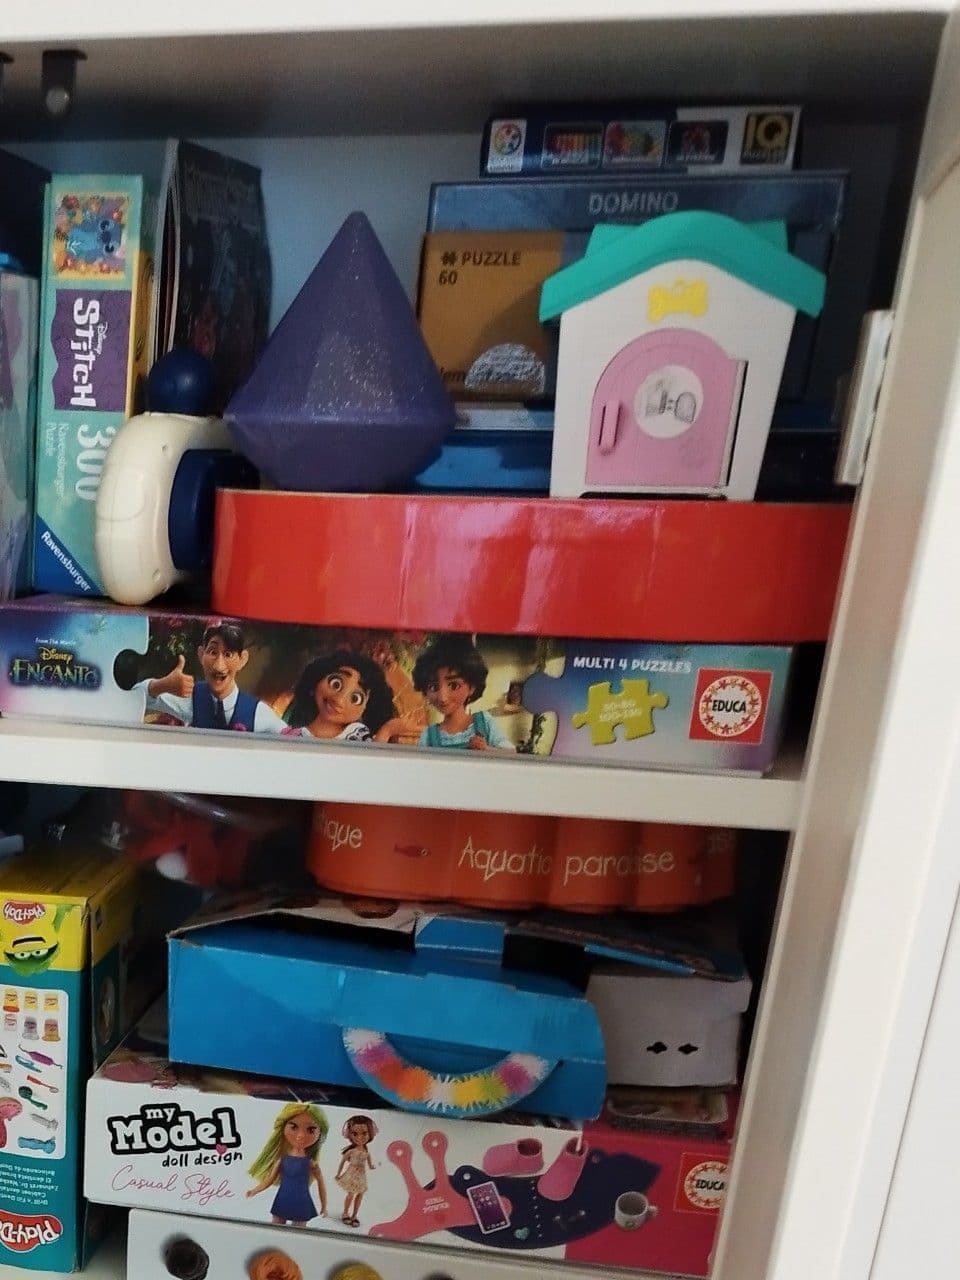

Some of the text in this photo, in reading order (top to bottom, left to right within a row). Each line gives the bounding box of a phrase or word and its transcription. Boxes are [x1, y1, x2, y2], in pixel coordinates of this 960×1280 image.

[588, 192, 679, 217] DOMINO
[461, 250, 522, 267] PUZZLE
[438, 270, 458, 286] 60
[41, 530, 92, 592] Ravensburger
[39, 647, 73, 664] Disney
[9, 659, 100, 686] ENCANTO
[573, 656, 693, 674] MULTI 4 PUZZLES
[711, 699, 747, 713] EDUCA
[458, 836, 551, 881] Aquatic
[145, 1107, 176, 1122] my
[111, 1112, 236, 1150] Model
[162, 1152, 243, 1168] doll design
[111, 1164, 236, 1206] Casual Style
